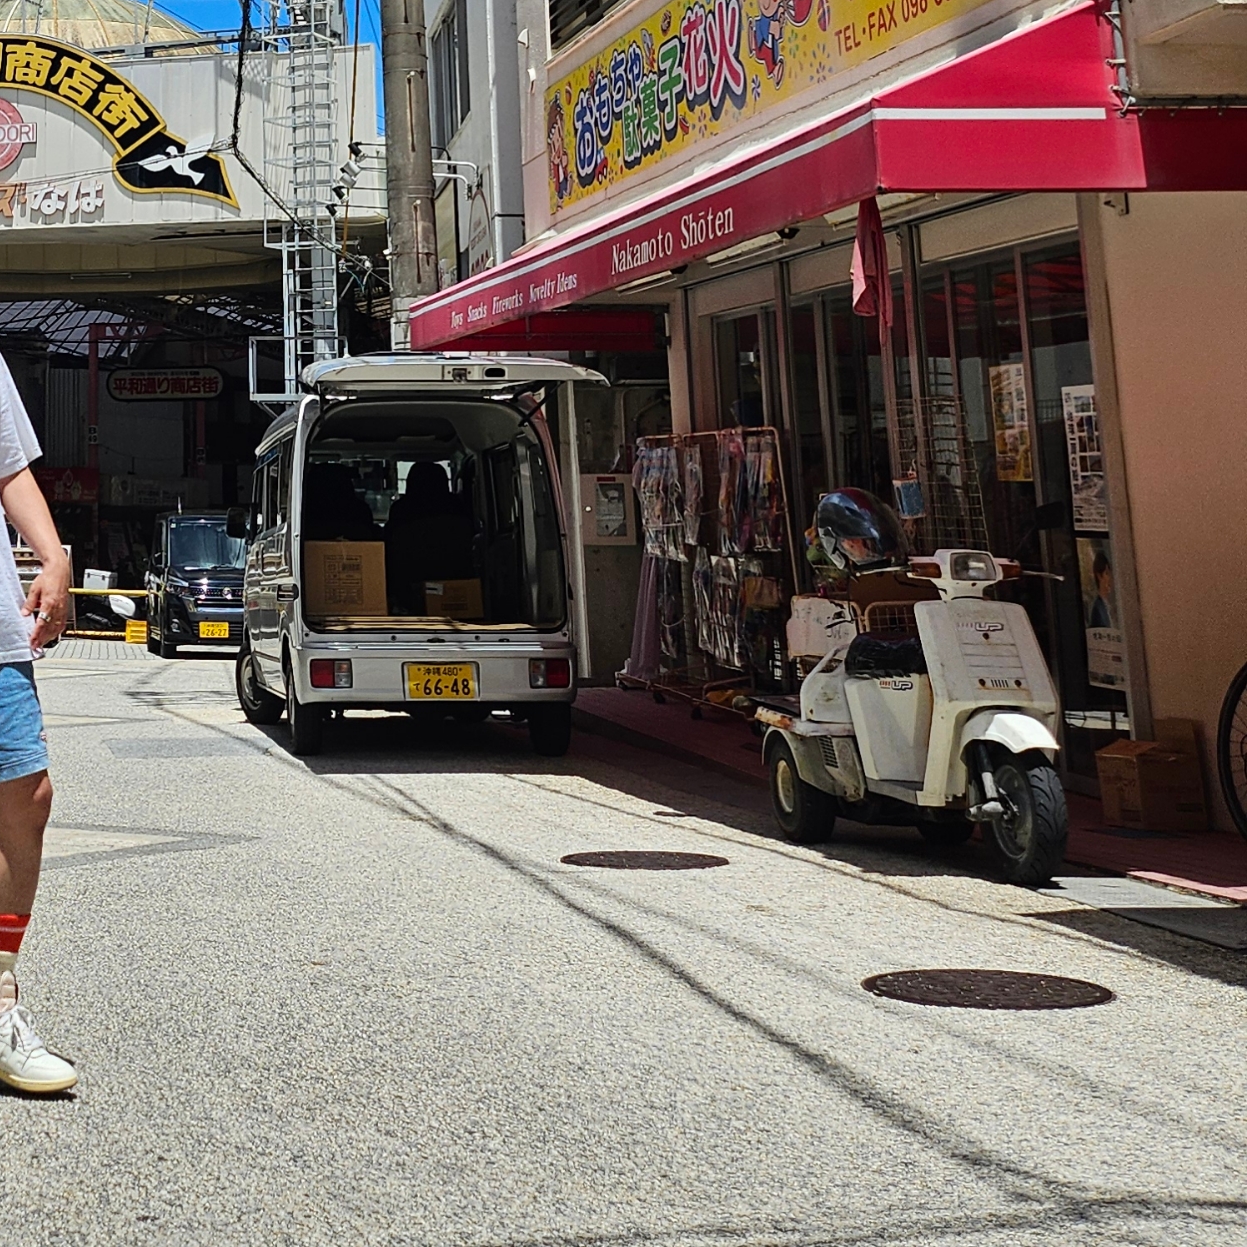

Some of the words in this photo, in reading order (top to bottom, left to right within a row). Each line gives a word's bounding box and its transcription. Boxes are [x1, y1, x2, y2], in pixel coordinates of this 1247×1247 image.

[574, 42, 644, 186] おもちゃ
[622, 37, 683, 168] 駄菓子
[610, 230, 674, 276] Nakamoto
[467, 301, 487, 323] Snacks
[492, 289, 523, 315] Fireworks
[528, 277, 556, 305] Novelty
[113, 377, 219, 395] 平和通り商店街
[206, 628, 227, 637] 26-27
[413, 682, 421, 692] て
[423, 678, 471, 696] 66-48
